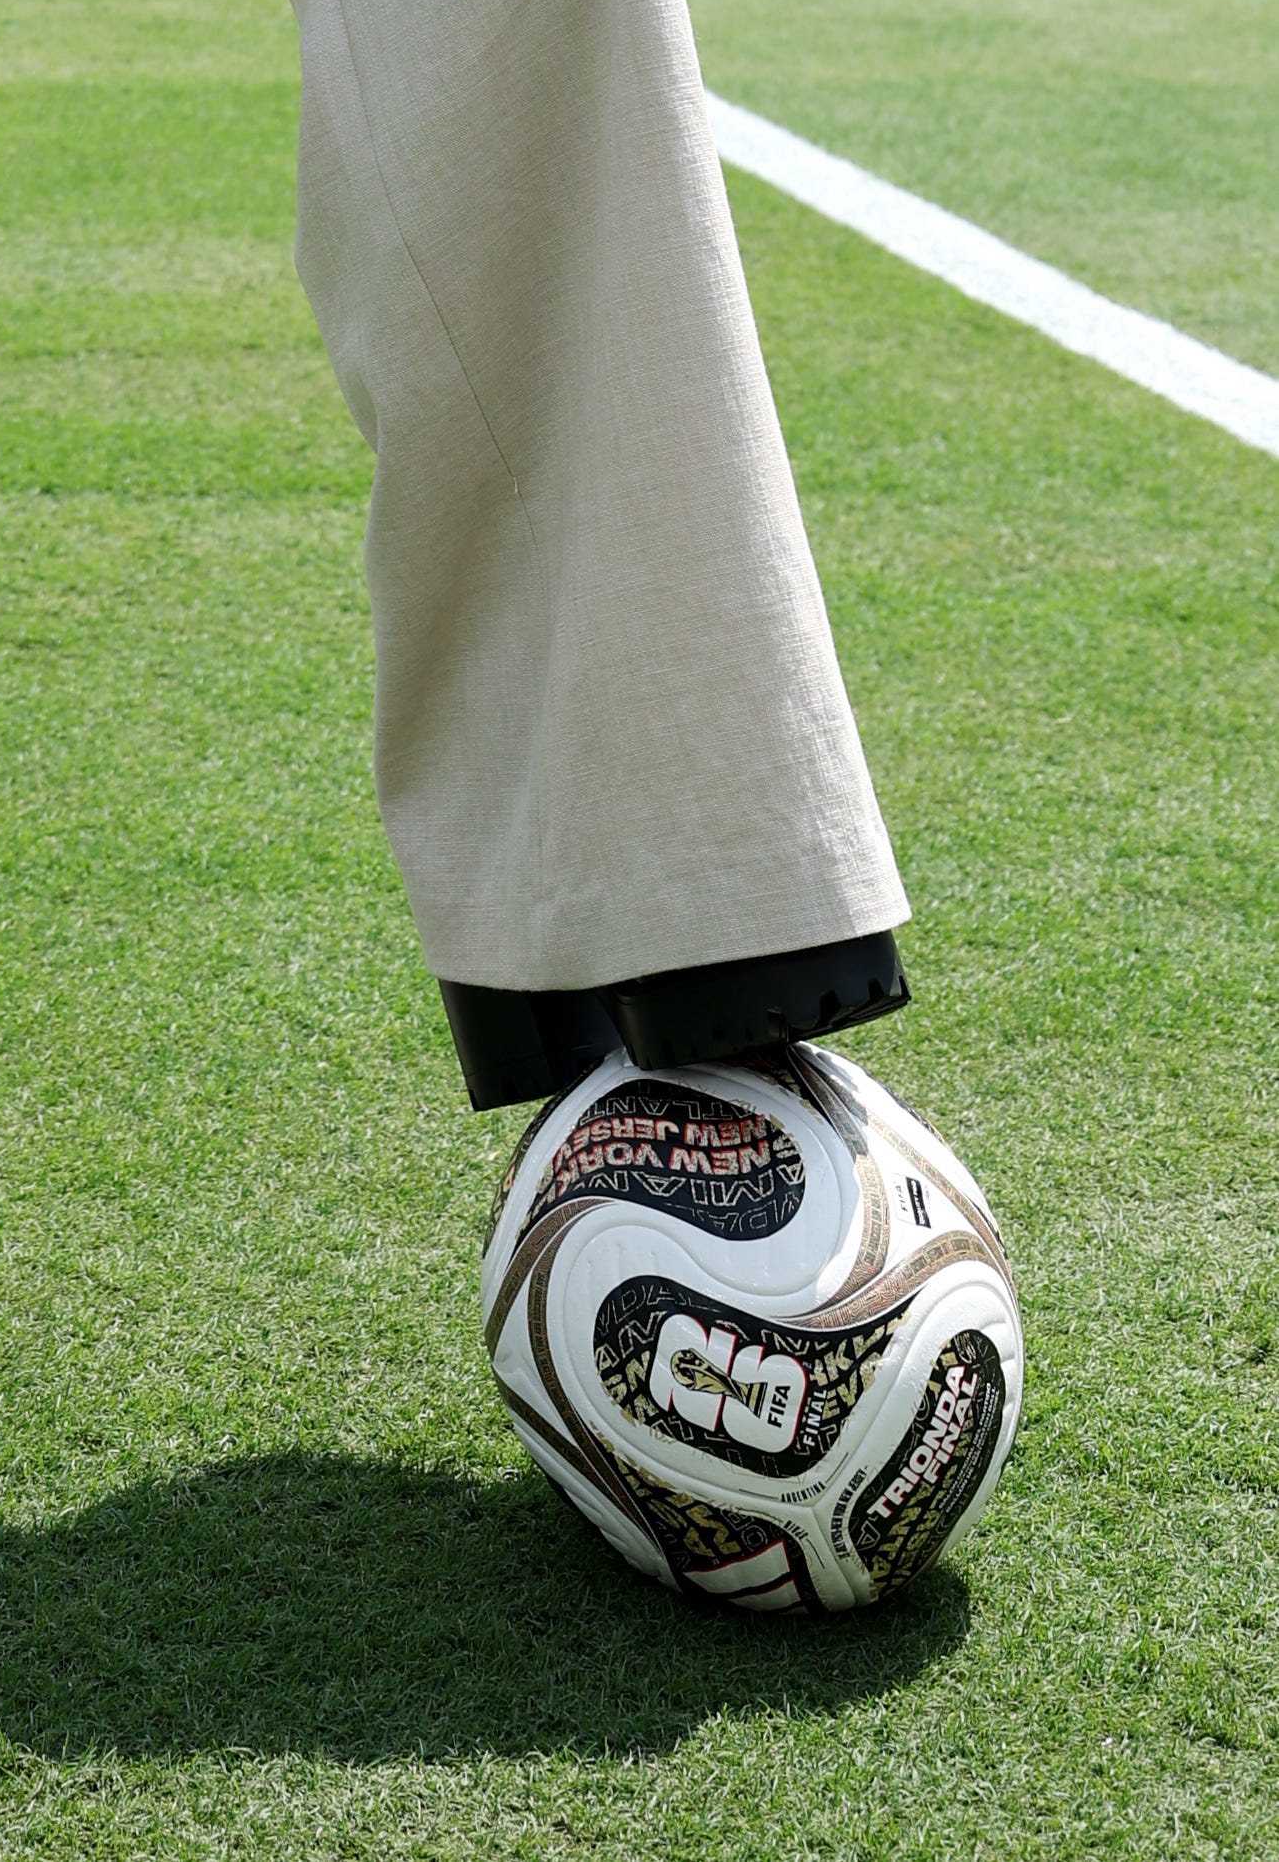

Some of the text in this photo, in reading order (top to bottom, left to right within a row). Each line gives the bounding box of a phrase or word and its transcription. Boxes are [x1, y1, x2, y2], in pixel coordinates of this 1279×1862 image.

[683, 1114, 768, 1148] NEW
[555, 1139, 772, 1198] NEW YORK
[895, 1185, 908, 1212] FIFA
[767, 1385, 791, 1428] FIFA
[803, 1389, 828, 1447] FINAL
[923, 1373, 978, 1485] FINAL
[867, 1364, 966, 1519] TRIONDA
[781, 1480, 827, 1504] ARGENTINA
